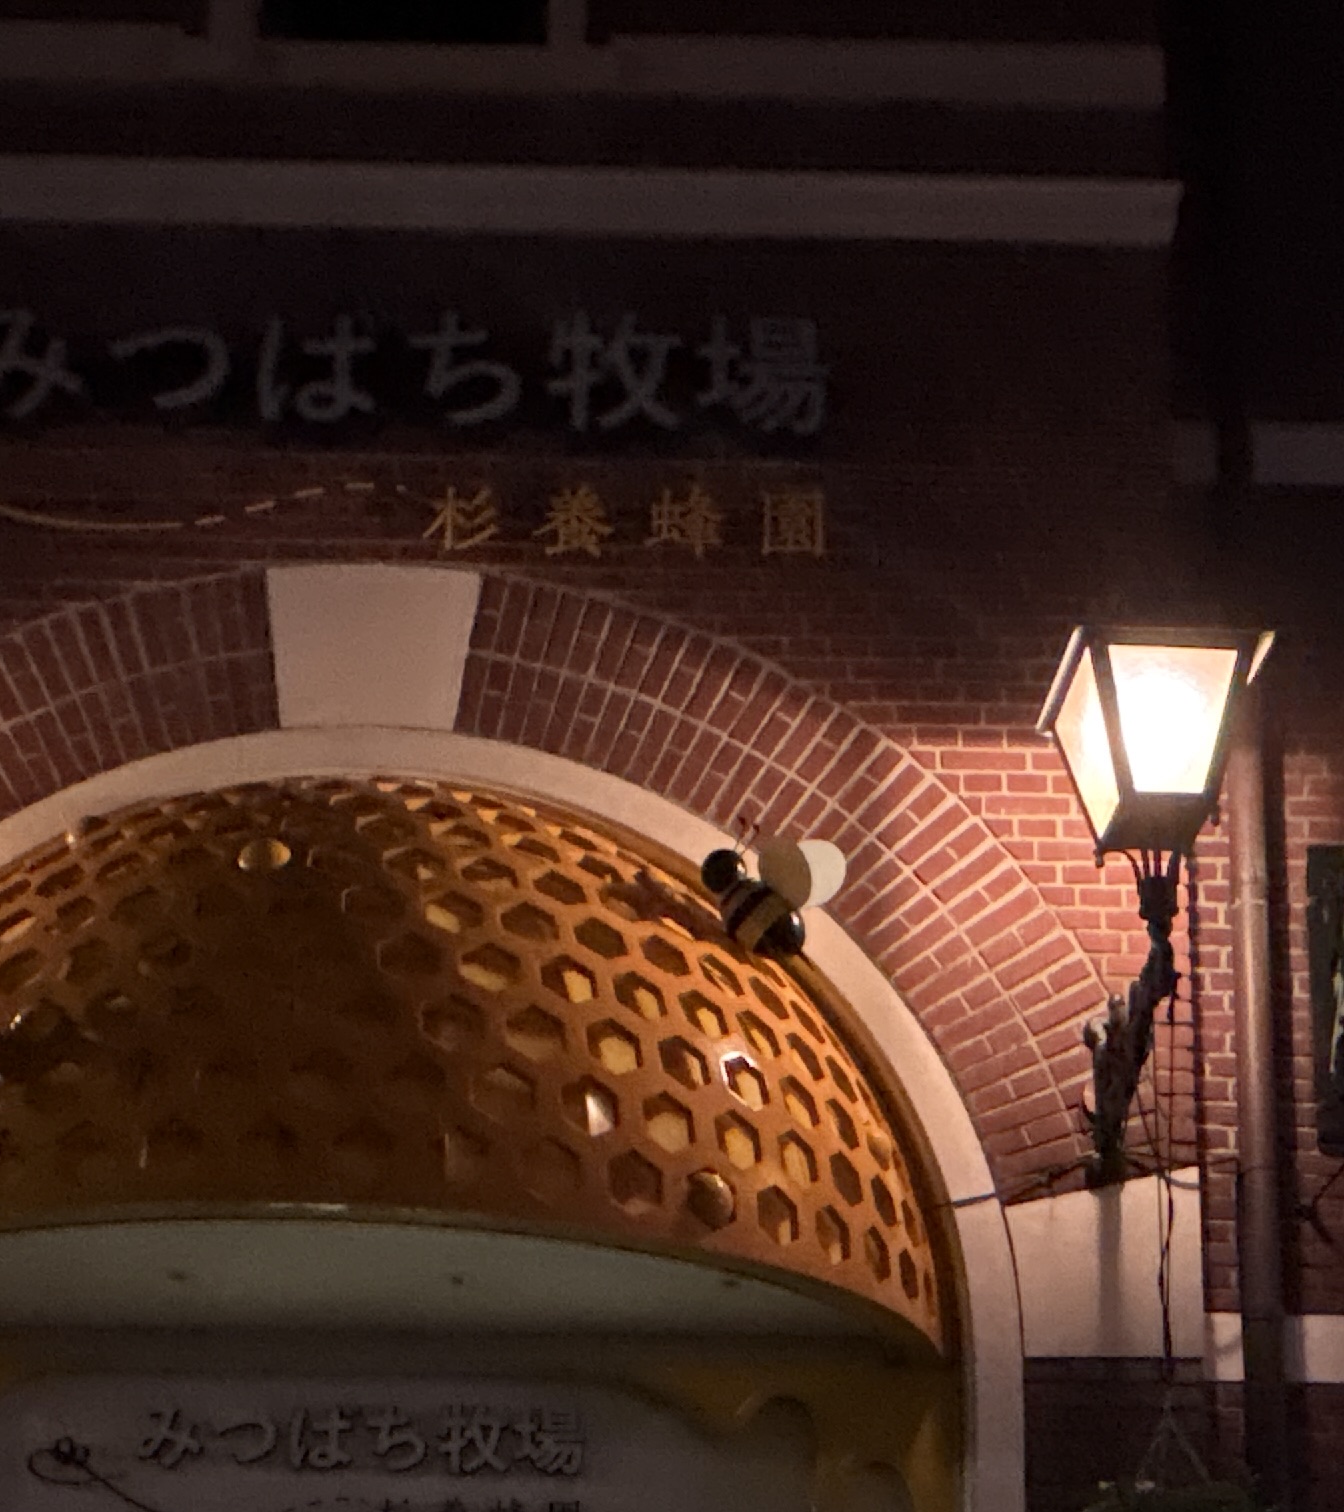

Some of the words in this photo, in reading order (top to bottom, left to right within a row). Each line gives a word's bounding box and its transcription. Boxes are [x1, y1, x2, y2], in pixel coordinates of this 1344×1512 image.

[422, 483, 826, 558] 杉養蜂園
[138, 1403, 584, 1477] みつばち牧場
